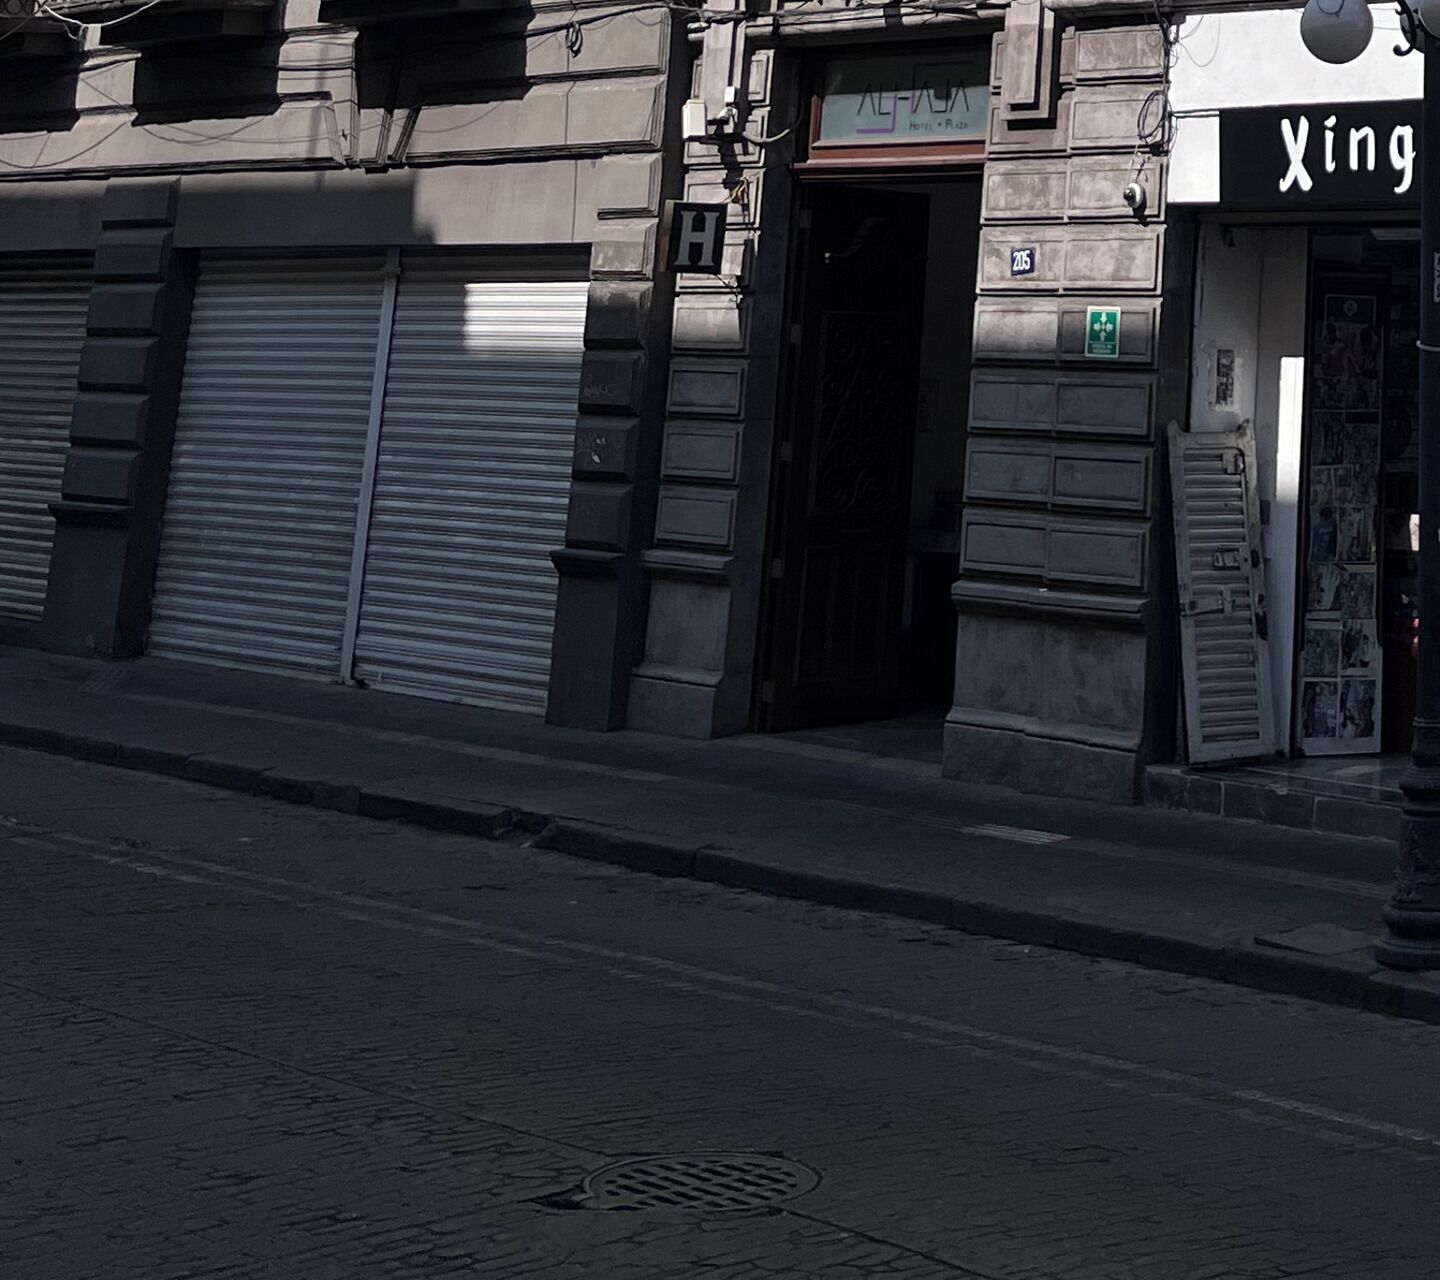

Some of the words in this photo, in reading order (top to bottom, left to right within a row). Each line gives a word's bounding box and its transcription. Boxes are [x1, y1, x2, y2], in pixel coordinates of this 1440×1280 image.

[1279, 115, 1417, 194] Xing
[674, 211, 720, 266] H
[1012, 250, 1031, 271] 205
